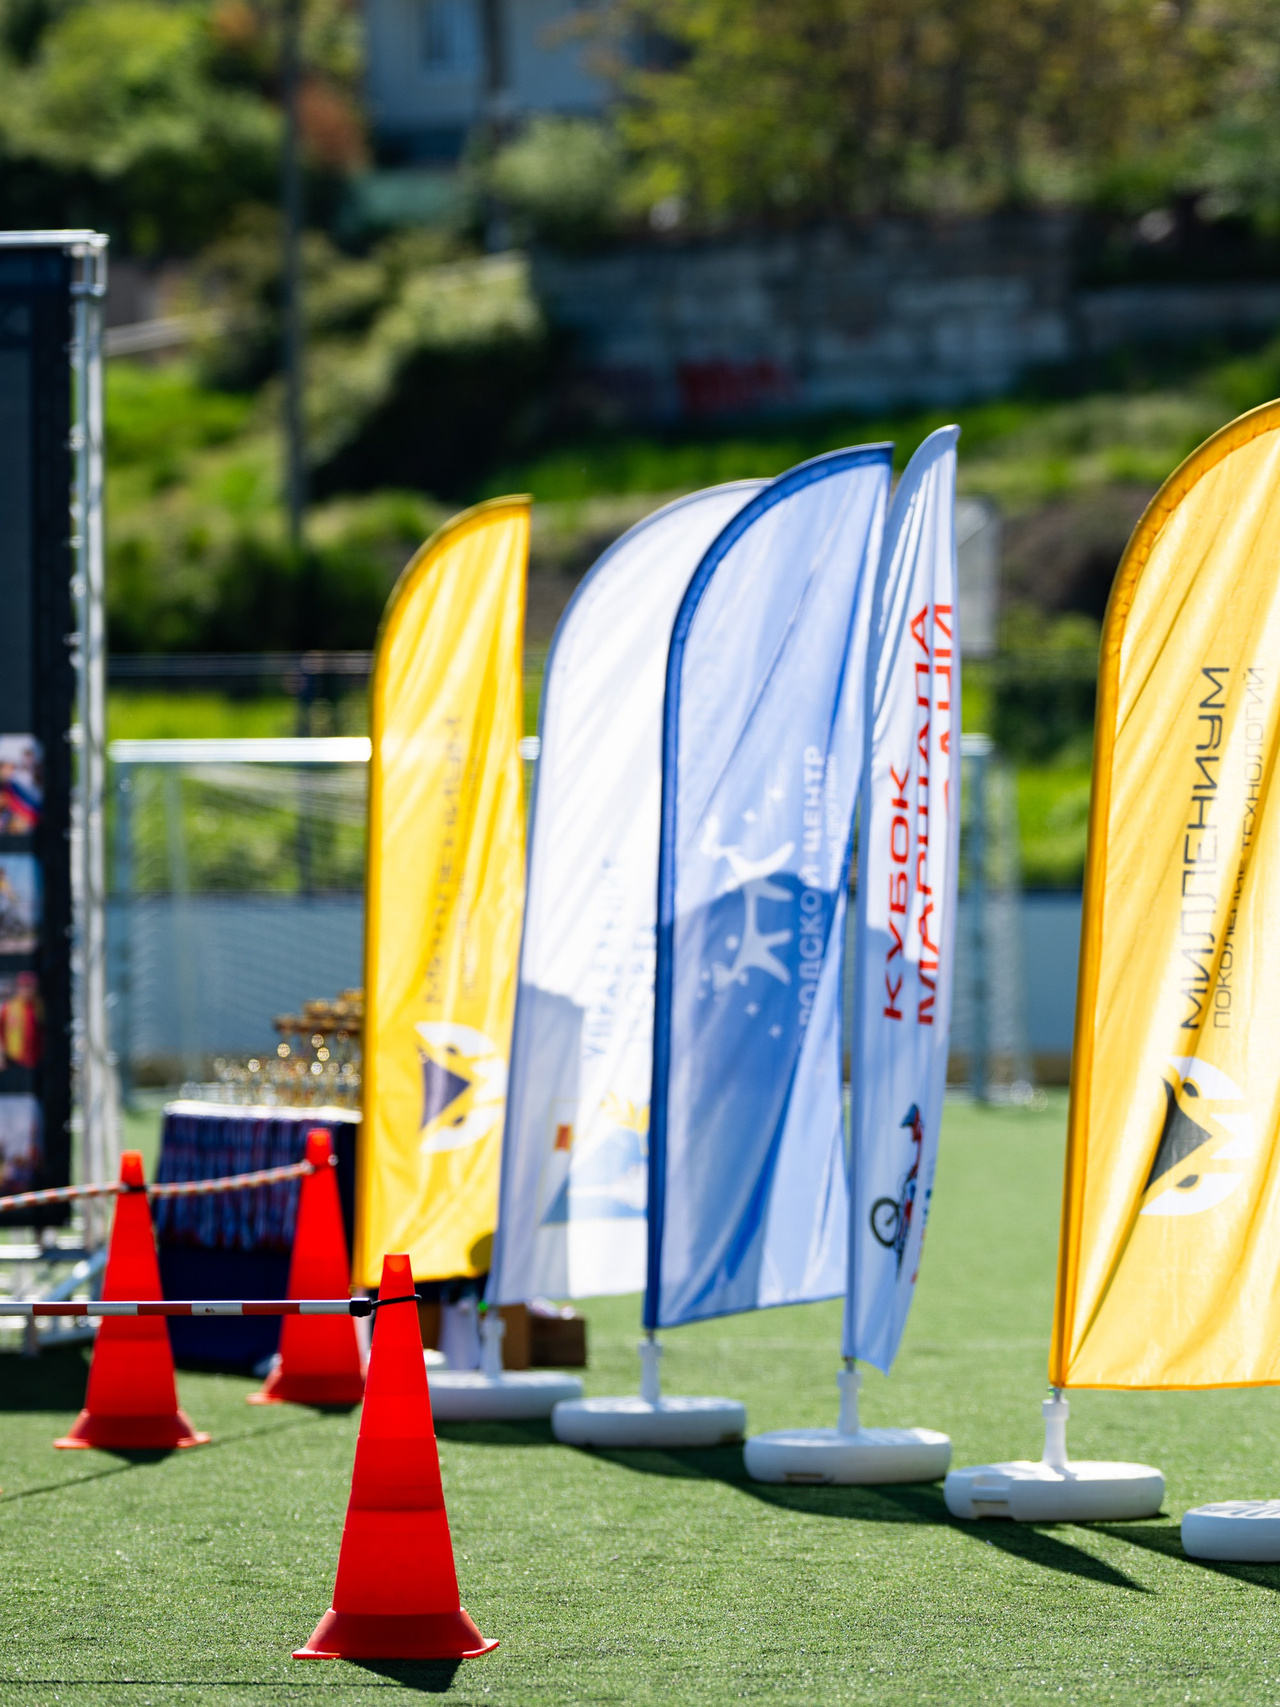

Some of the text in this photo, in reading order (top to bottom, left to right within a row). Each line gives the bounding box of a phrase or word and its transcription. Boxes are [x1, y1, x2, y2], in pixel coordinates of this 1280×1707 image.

[803, 745, 825, 853] ЦЕНТР
[1180, 667, 1230, 1031] МИЛЛЕНИУМ
[1241, 667, 1265, 852] ТЕХНОЛОГИЙ
[883, 763, 910, 1021] КУБОК
